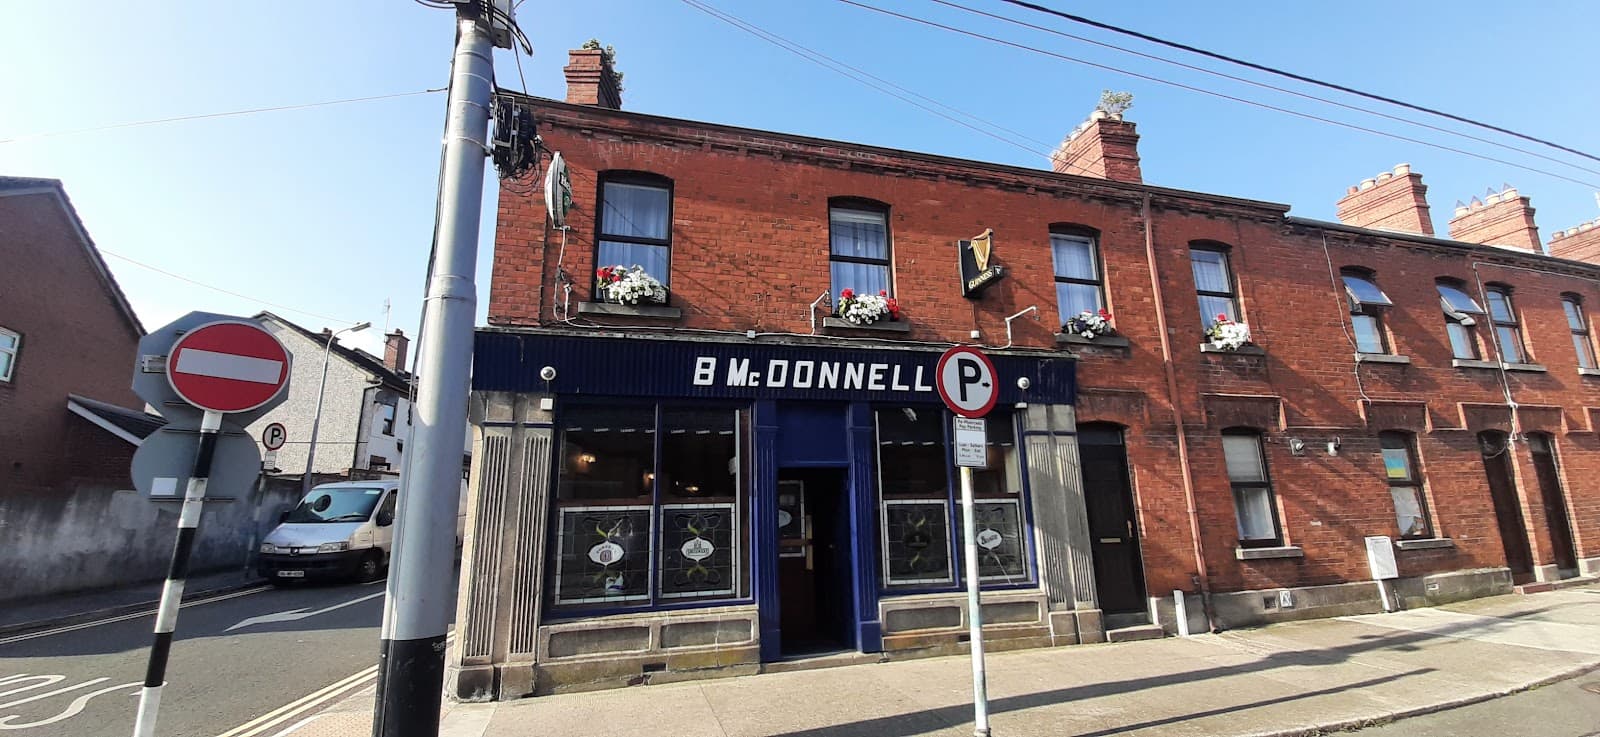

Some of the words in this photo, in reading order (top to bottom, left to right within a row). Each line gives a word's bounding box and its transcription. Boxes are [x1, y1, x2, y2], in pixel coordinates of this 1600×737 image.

[968, 268, 993, 289] GUINNESS
[693, 356, 717, 386] B
[958, 359, 981, 401] P
[271, 428, 281, 445] P
